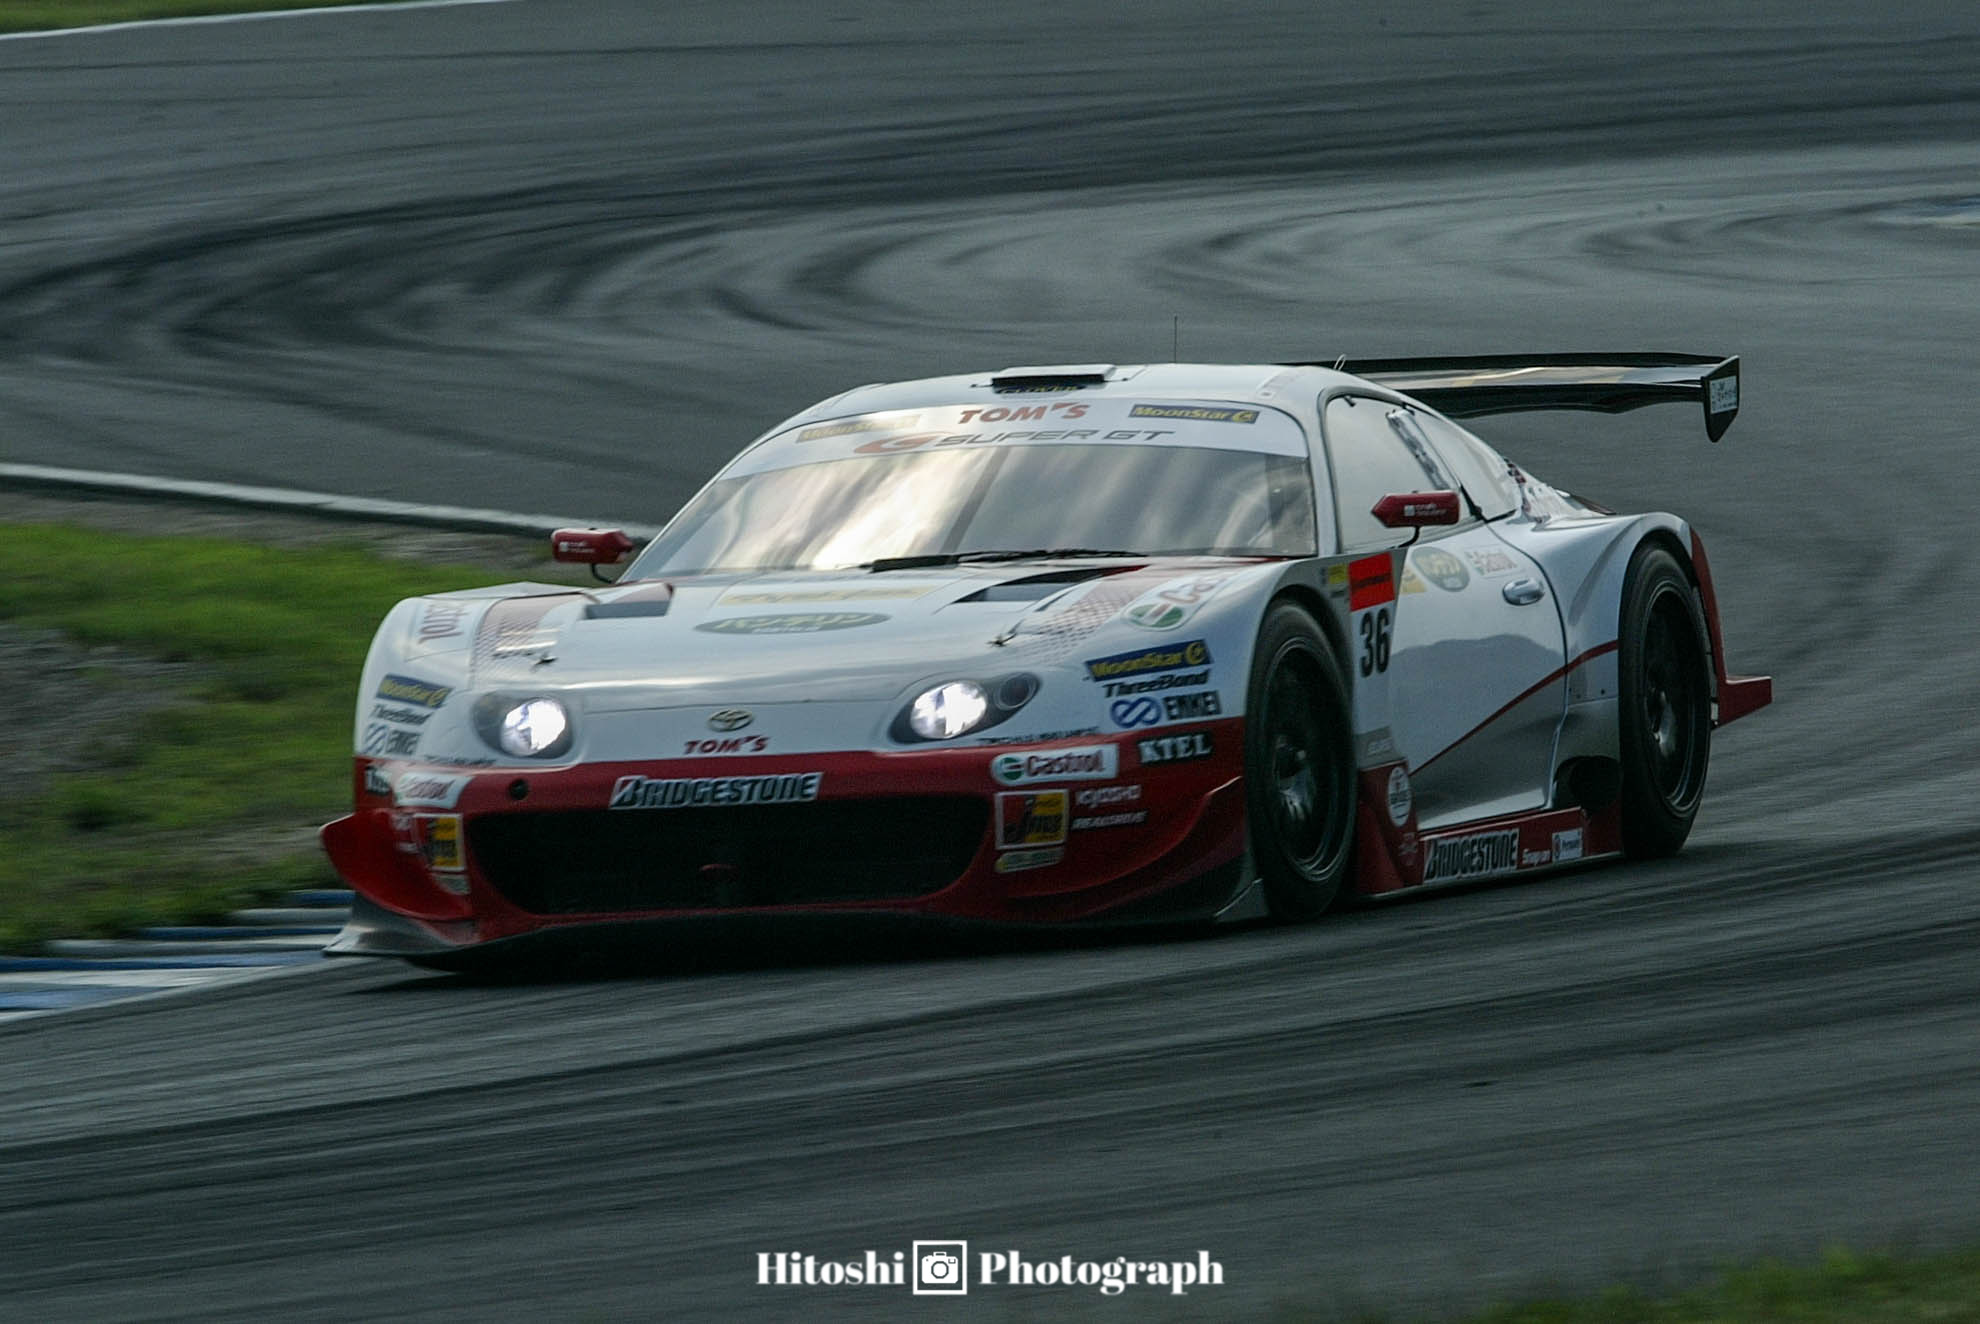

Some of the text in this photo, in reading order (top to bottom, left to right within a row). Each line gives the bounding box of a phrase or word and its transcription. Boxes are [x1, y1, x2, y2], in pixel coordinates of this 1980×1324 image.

[957, 402, 1092, 425] TOM'S
[1133, 405, 1231, 421] MoonStar
[939, 429, 1178, 446] SUPER GT
[1360, 608, 1390, 678] 36
[684, 735, 771, 755] TOM'S
[1027, 750, 1106, 777] Castrol
[610, 772, 825, 810] BRIDGESTONE
[1424, 828, 1520, 883] BRIDGESTONE
